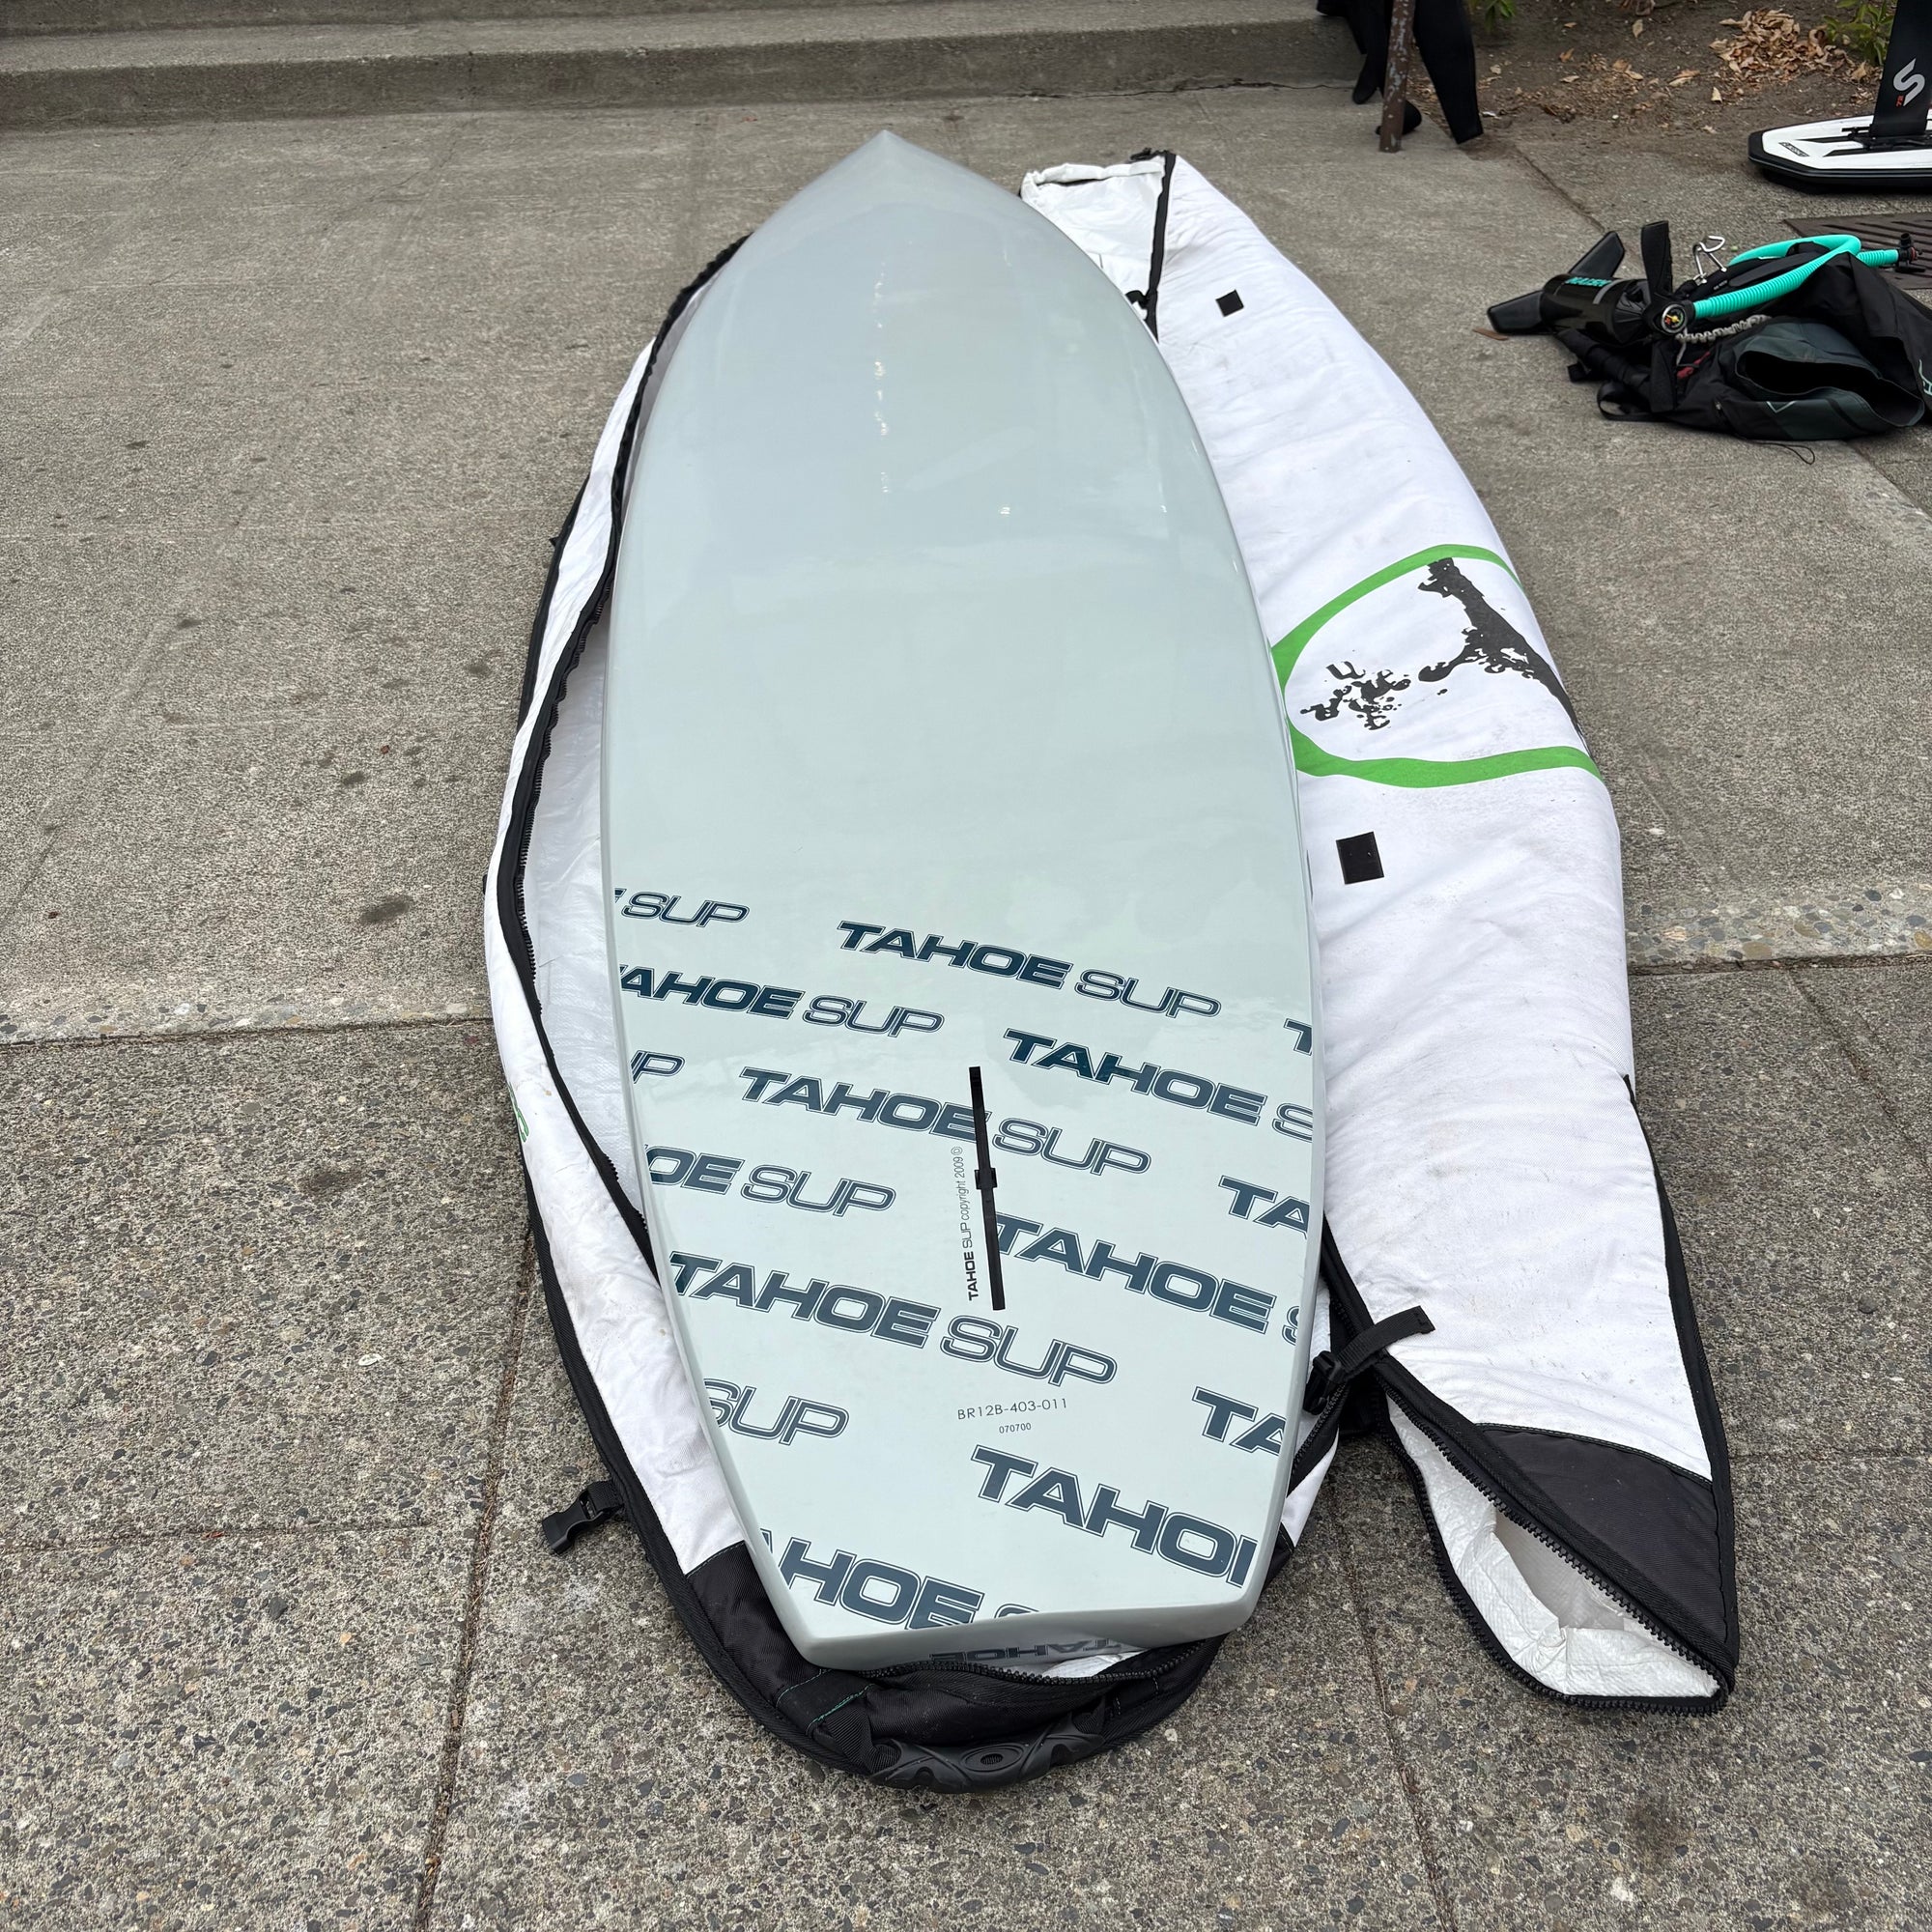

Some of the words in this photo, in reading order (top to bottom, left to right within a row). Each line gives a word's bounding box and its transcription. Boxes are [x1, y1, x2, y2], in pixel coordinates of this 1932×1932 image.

[621, 891, 750, 927] SUP
[837, 921, 1074, 990] TAHOE
[1074, 969, 1222, 1018] SUP
[619, 964, 806, 1019] AHOE
[802, 995, 945, 1037] SUP
[1003, 1028, 1267, 1126] TAHOE
[739, 1066, 990, 1143] TAHOE
[992, 1118, 1151, 1176] SUP
[740, 1164, 896, 1217] SUP
[952, 1156, 965, 1179] 2009
[956, 1180, 970, 1220] copyright
[960, 1222, 973, 1248] SUP
[963, 1251, 979, 1301] TAHOE
[995, 1211, 1276, 1334] TAHOE
[669, 1250, 941, 1350] TAHOE
[940, 1314, 1117, 1386] SUP
[957, 1398, 1067, 1420] BR12B-403-011
[999, 1422, 1032, 1434] 070700
[760, 1528, 984, 1631] HOE
